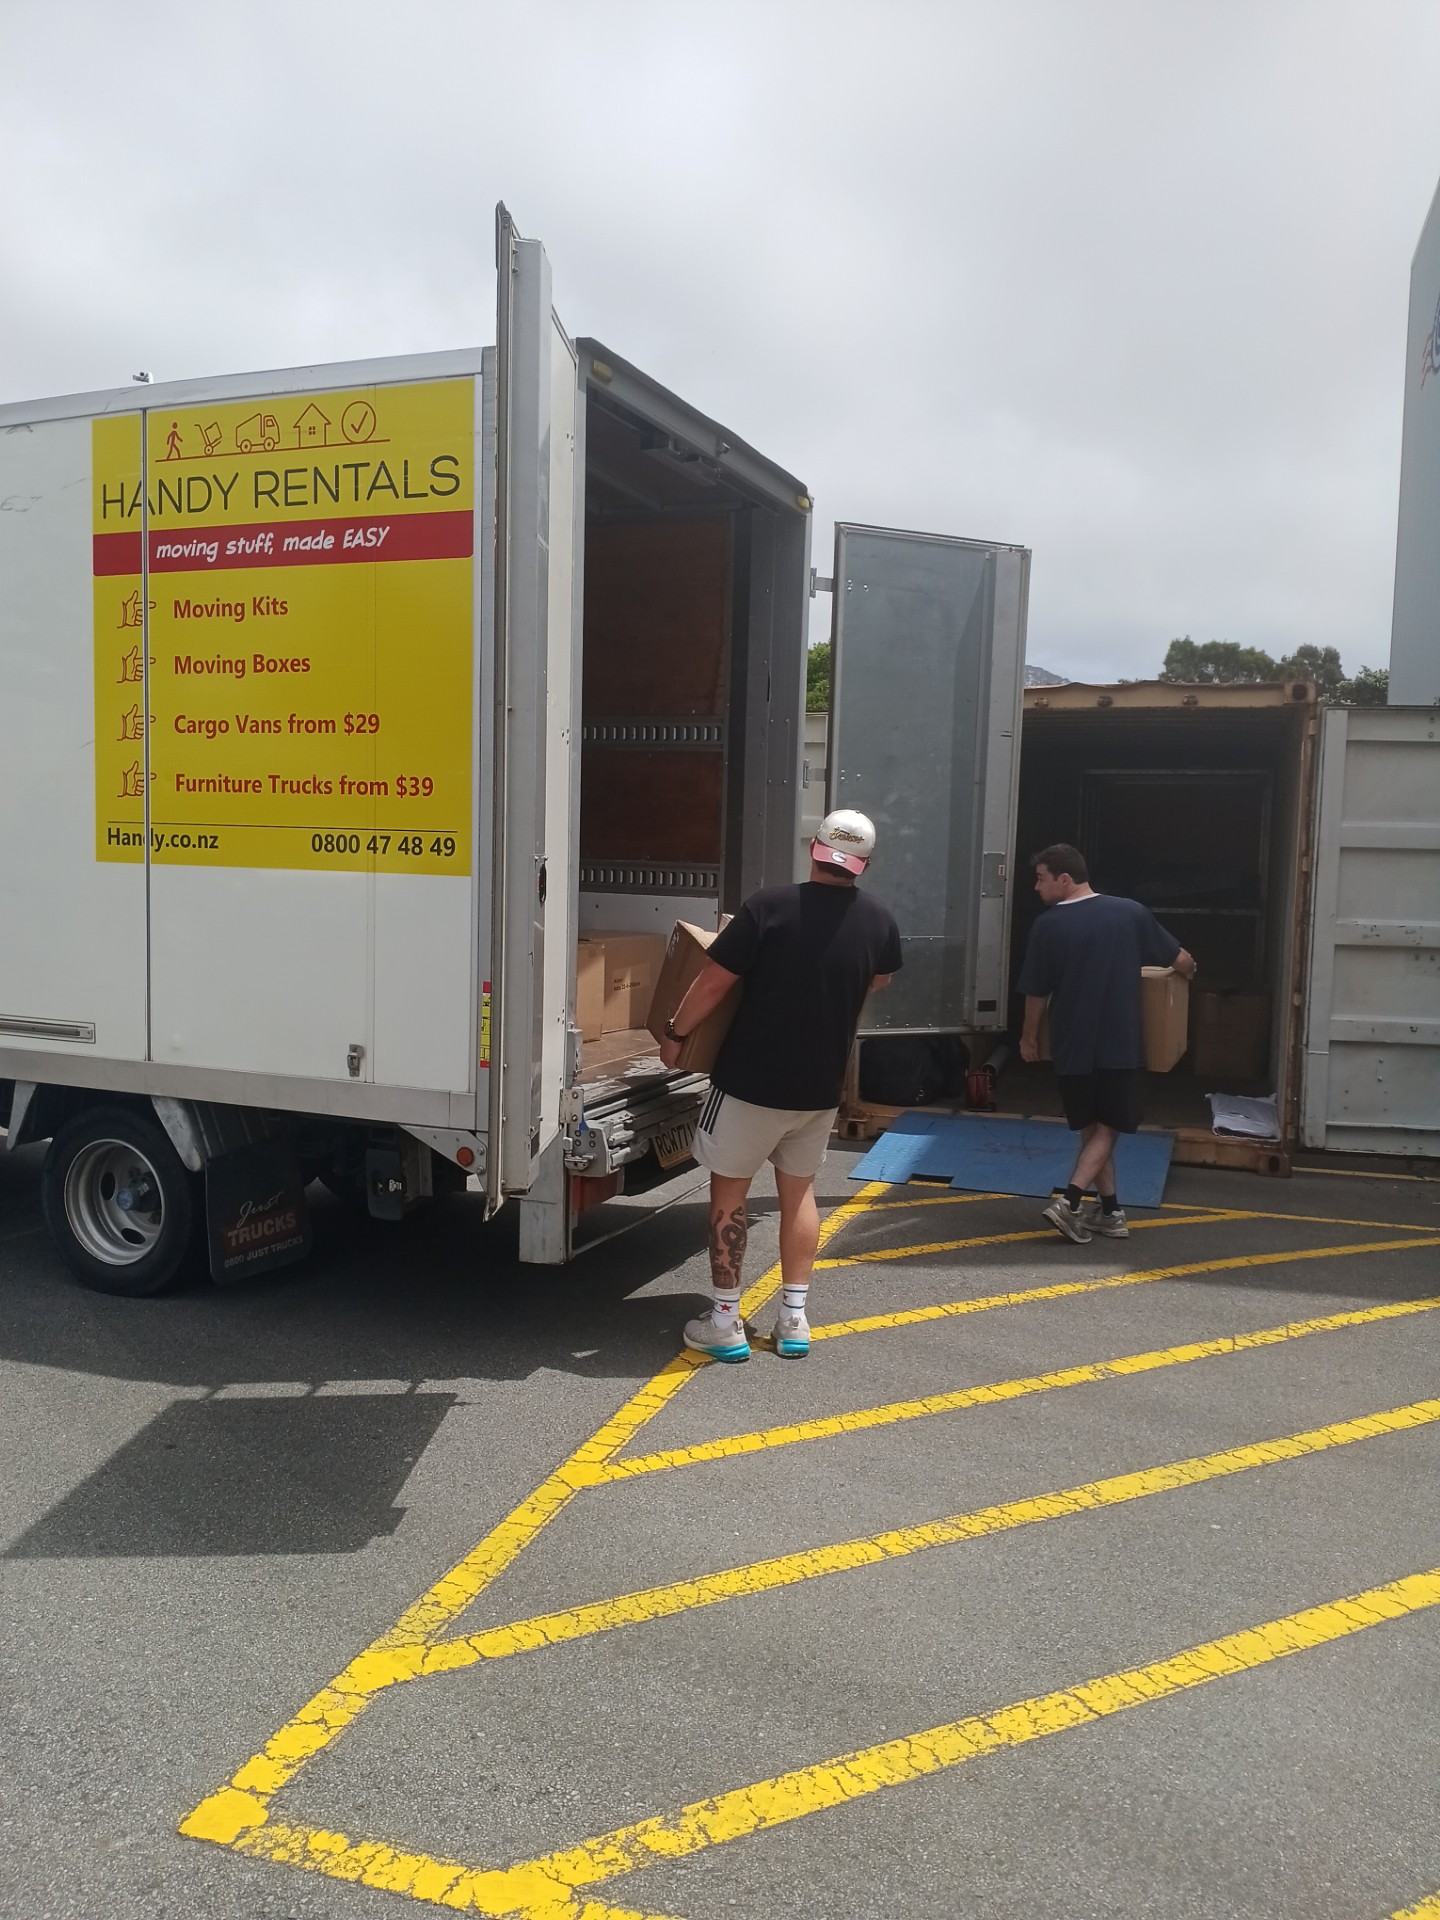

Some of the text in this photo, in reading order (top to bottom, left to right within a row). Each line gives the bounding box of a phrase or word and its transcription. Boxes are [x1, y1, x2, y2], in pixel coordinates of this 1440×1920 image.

[102, 455, 461, 519] HANDY RENTALS
[156, 525, 391, 562] moving stuff, made EASY
[173, 596, 289, 623] Moving Kits
[173, 653, 311, 679] Moving Boxes
[173, 712, 381, 739] Cargo Vans from $29
[175, 772, 434, 799] Furniture Trucks from $39
[311, 833, 456, 857] 0800 47 48 49
[236, 1190, 285, 1229] Just
[227, 1212, 297, 1247] TRUCKS
[247, 1246, 270, 1260] JUST
[271, 1235, 303, 1252] TRUCKS
